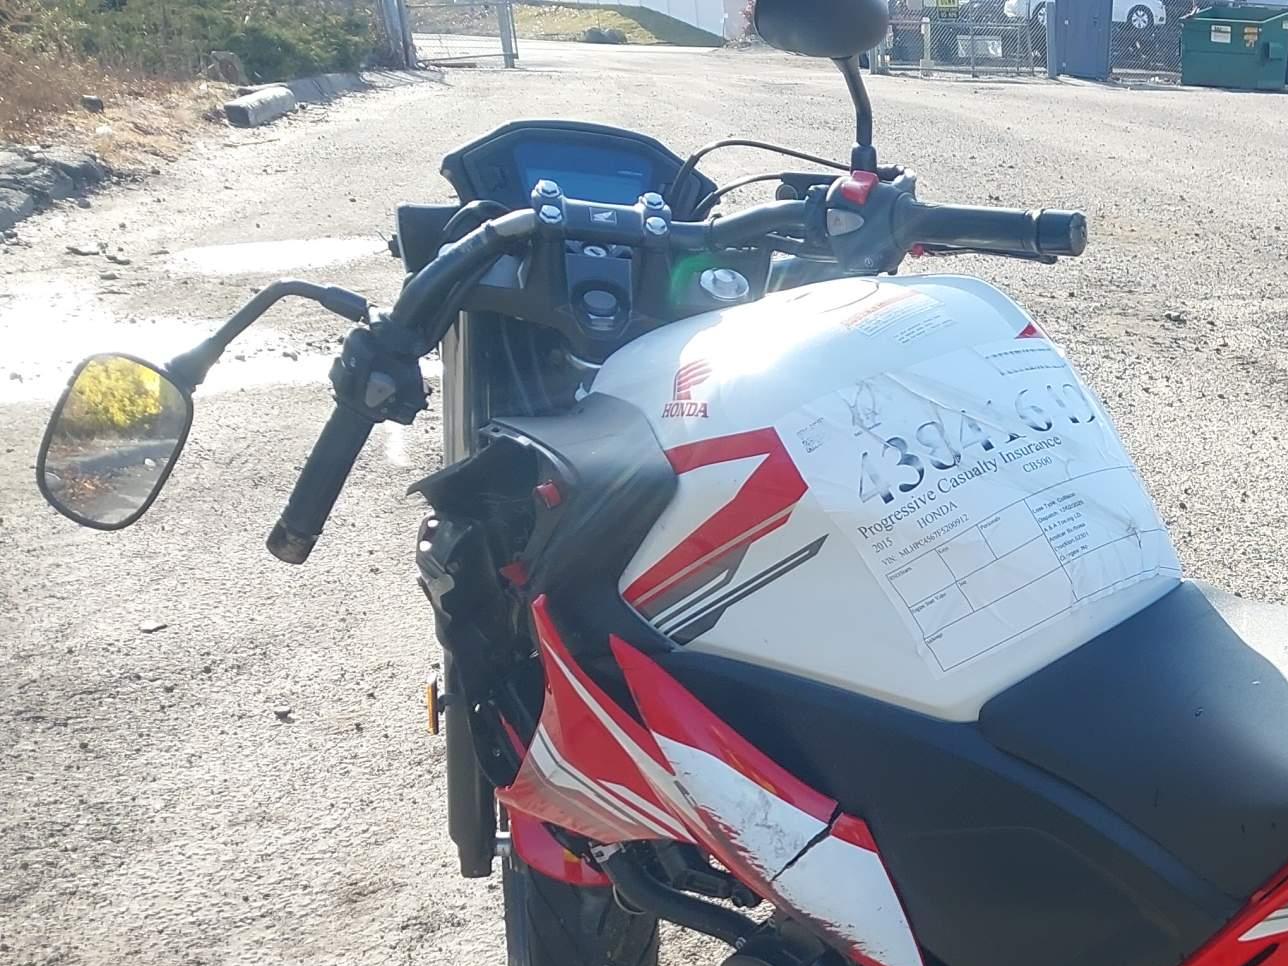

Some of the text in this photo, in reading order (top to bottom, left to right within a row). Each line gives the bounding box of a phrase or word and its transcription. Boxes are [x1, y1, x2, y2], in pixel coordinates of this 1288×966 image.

[661, 402, 709, 418] HONDA
[856, 434, 1063, 540] Progressive Casualty Insurance
[872, 455, 1053, 554] 2015 HONDA CB500
